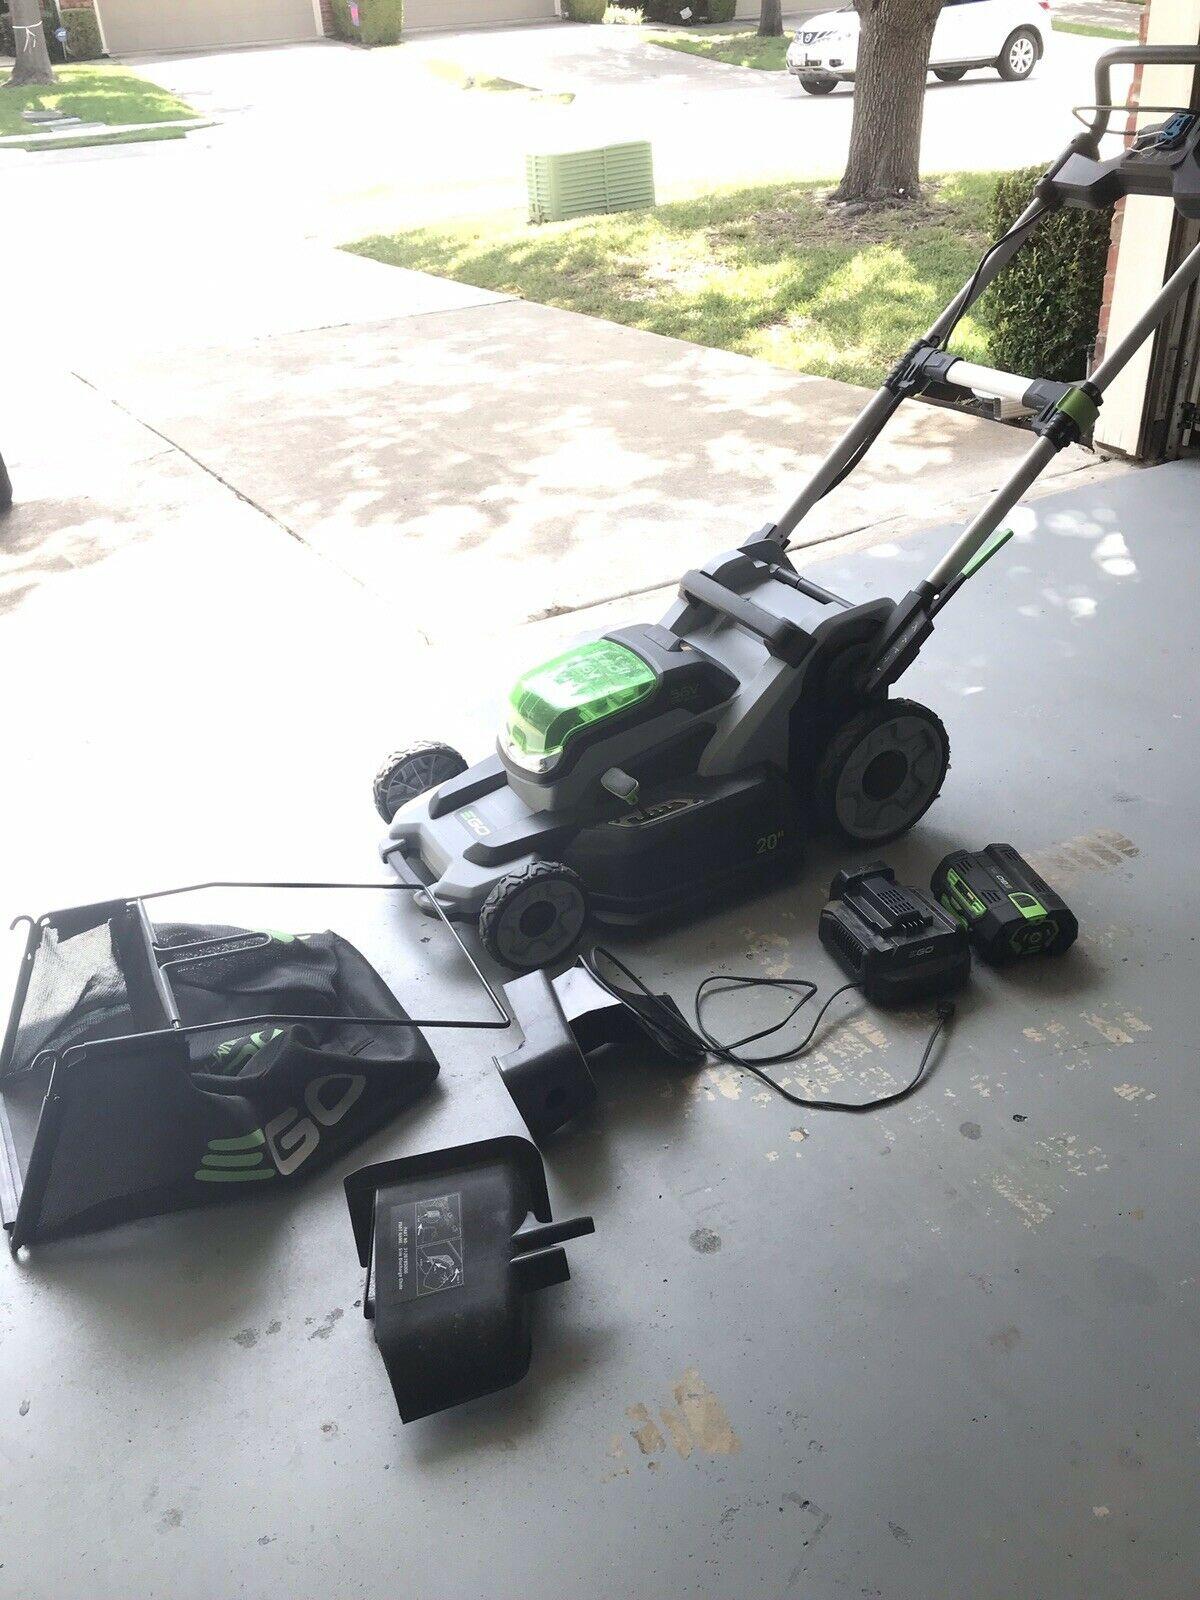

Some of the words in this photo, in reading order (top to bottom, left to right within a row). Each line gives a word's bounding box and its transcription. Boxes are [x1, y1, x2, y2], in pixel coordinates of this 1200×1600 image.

[460, 810, 491, 836] EGO
[908, 945, 934, 959] EGO
[194, 1073, 367, 1182] EGO
